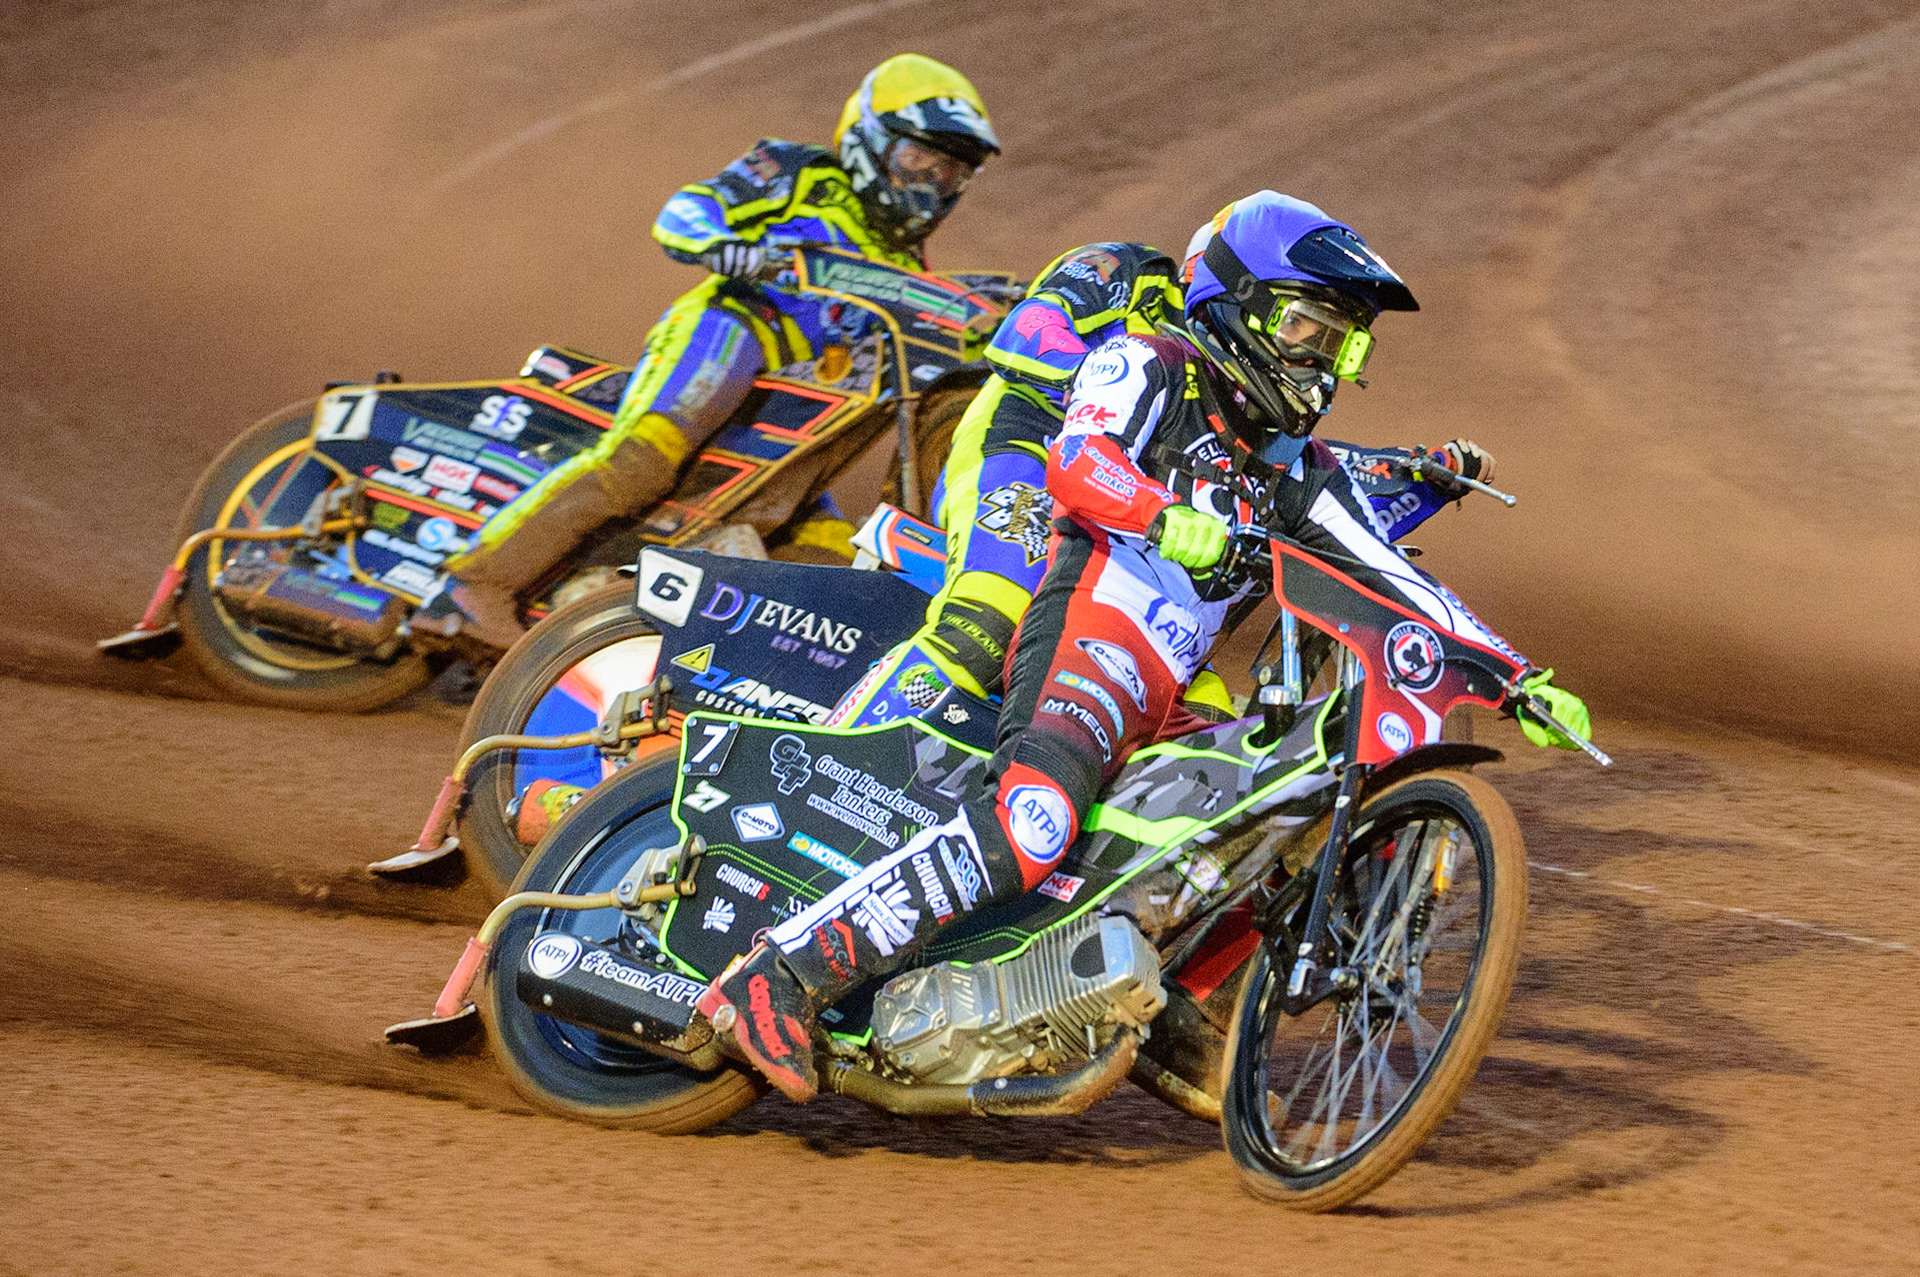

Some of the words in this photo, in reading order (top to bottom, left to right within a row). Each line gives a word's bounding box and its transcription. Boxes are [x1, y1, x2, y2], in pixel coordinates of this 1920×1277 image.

[335, 393, 364, 433] 7
[1091, 466, 1138, 499] Tankers
[649, 572, 688, 602] 6
[754, 600, 863, 654] EVANS
[691, 725, 730, 763] 7
[1384, 723, 1407, 742] ATPI
[815, 754, 860, 786] Grant
[854, 773, 939, 827] Henderson
[831, 784, 893, 827] Tankers
[806, 793, 900, 849] www.wemovesh.it
[1022, 798, 1061, 845] ATPI
[808, 842, 866, 879] MOTORE
[716, 863, 771, 901] CHURCHS
[1045, 875, 1081, 893] NGK
[538, 942, 570, 963] ATPI
